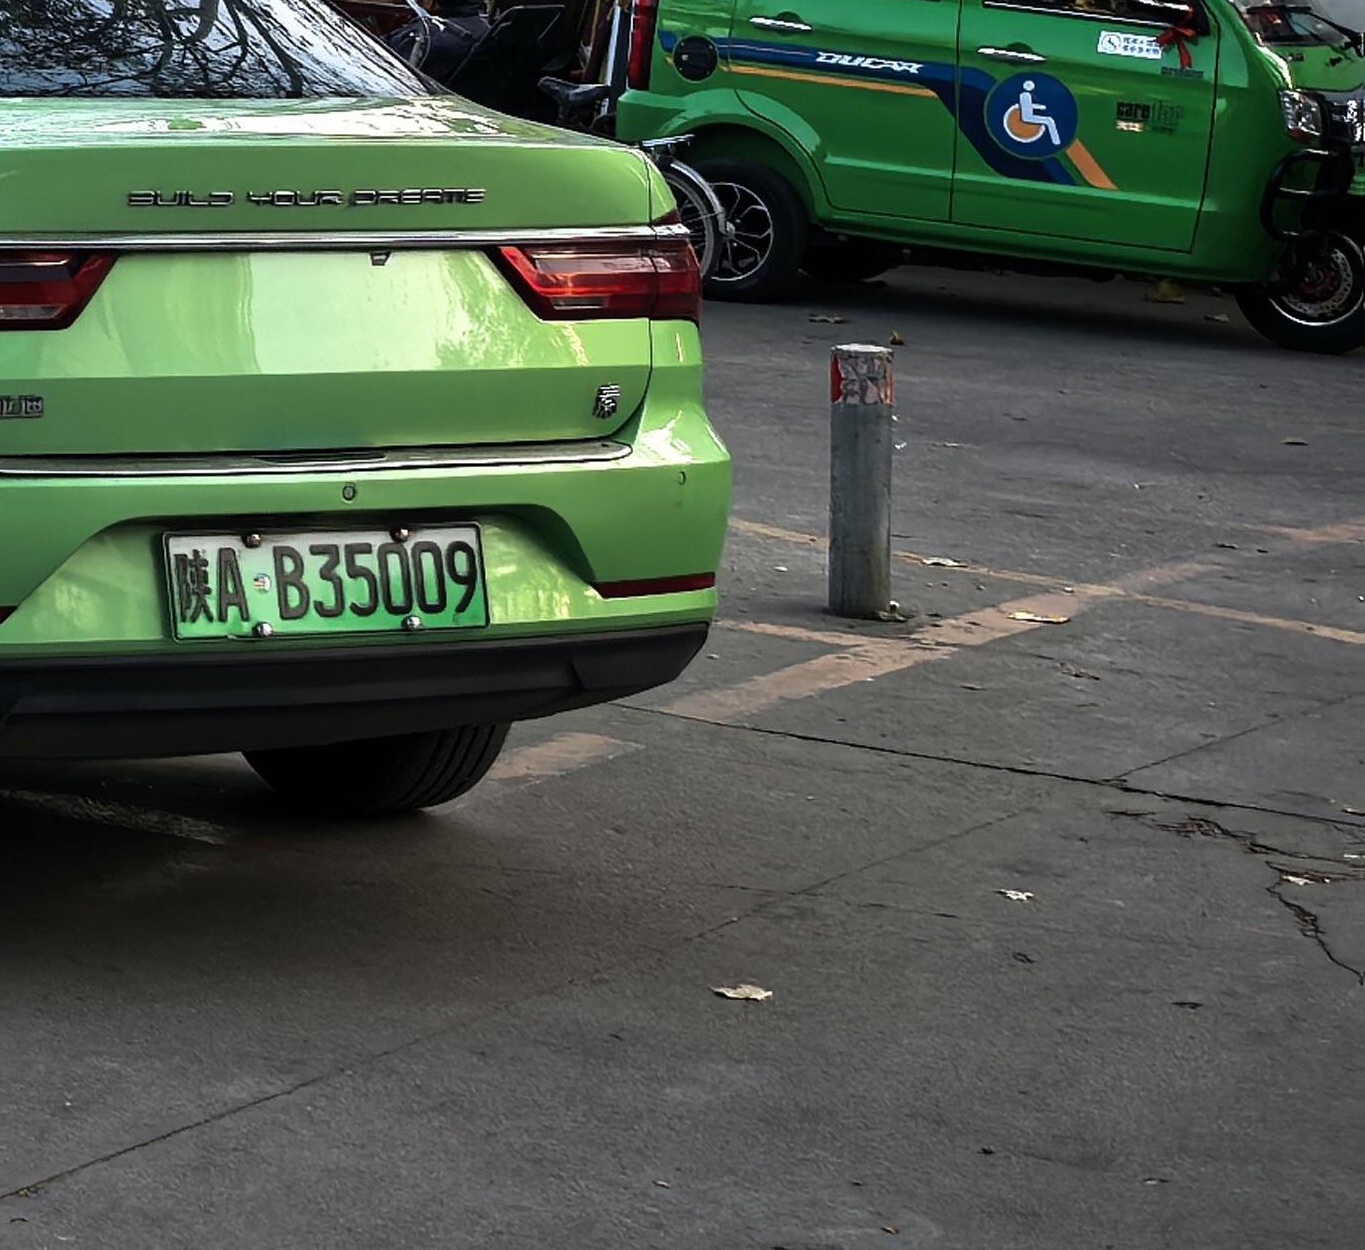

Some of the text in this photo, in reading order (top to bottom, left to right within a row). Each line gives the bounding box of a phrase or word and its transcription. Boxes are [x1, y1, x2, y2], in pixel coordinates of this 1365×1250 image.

[127, 190, 235, 207] BUILD
[246, 190, 344, 206] YOUR
[272, 539, 479, 621] B35009
